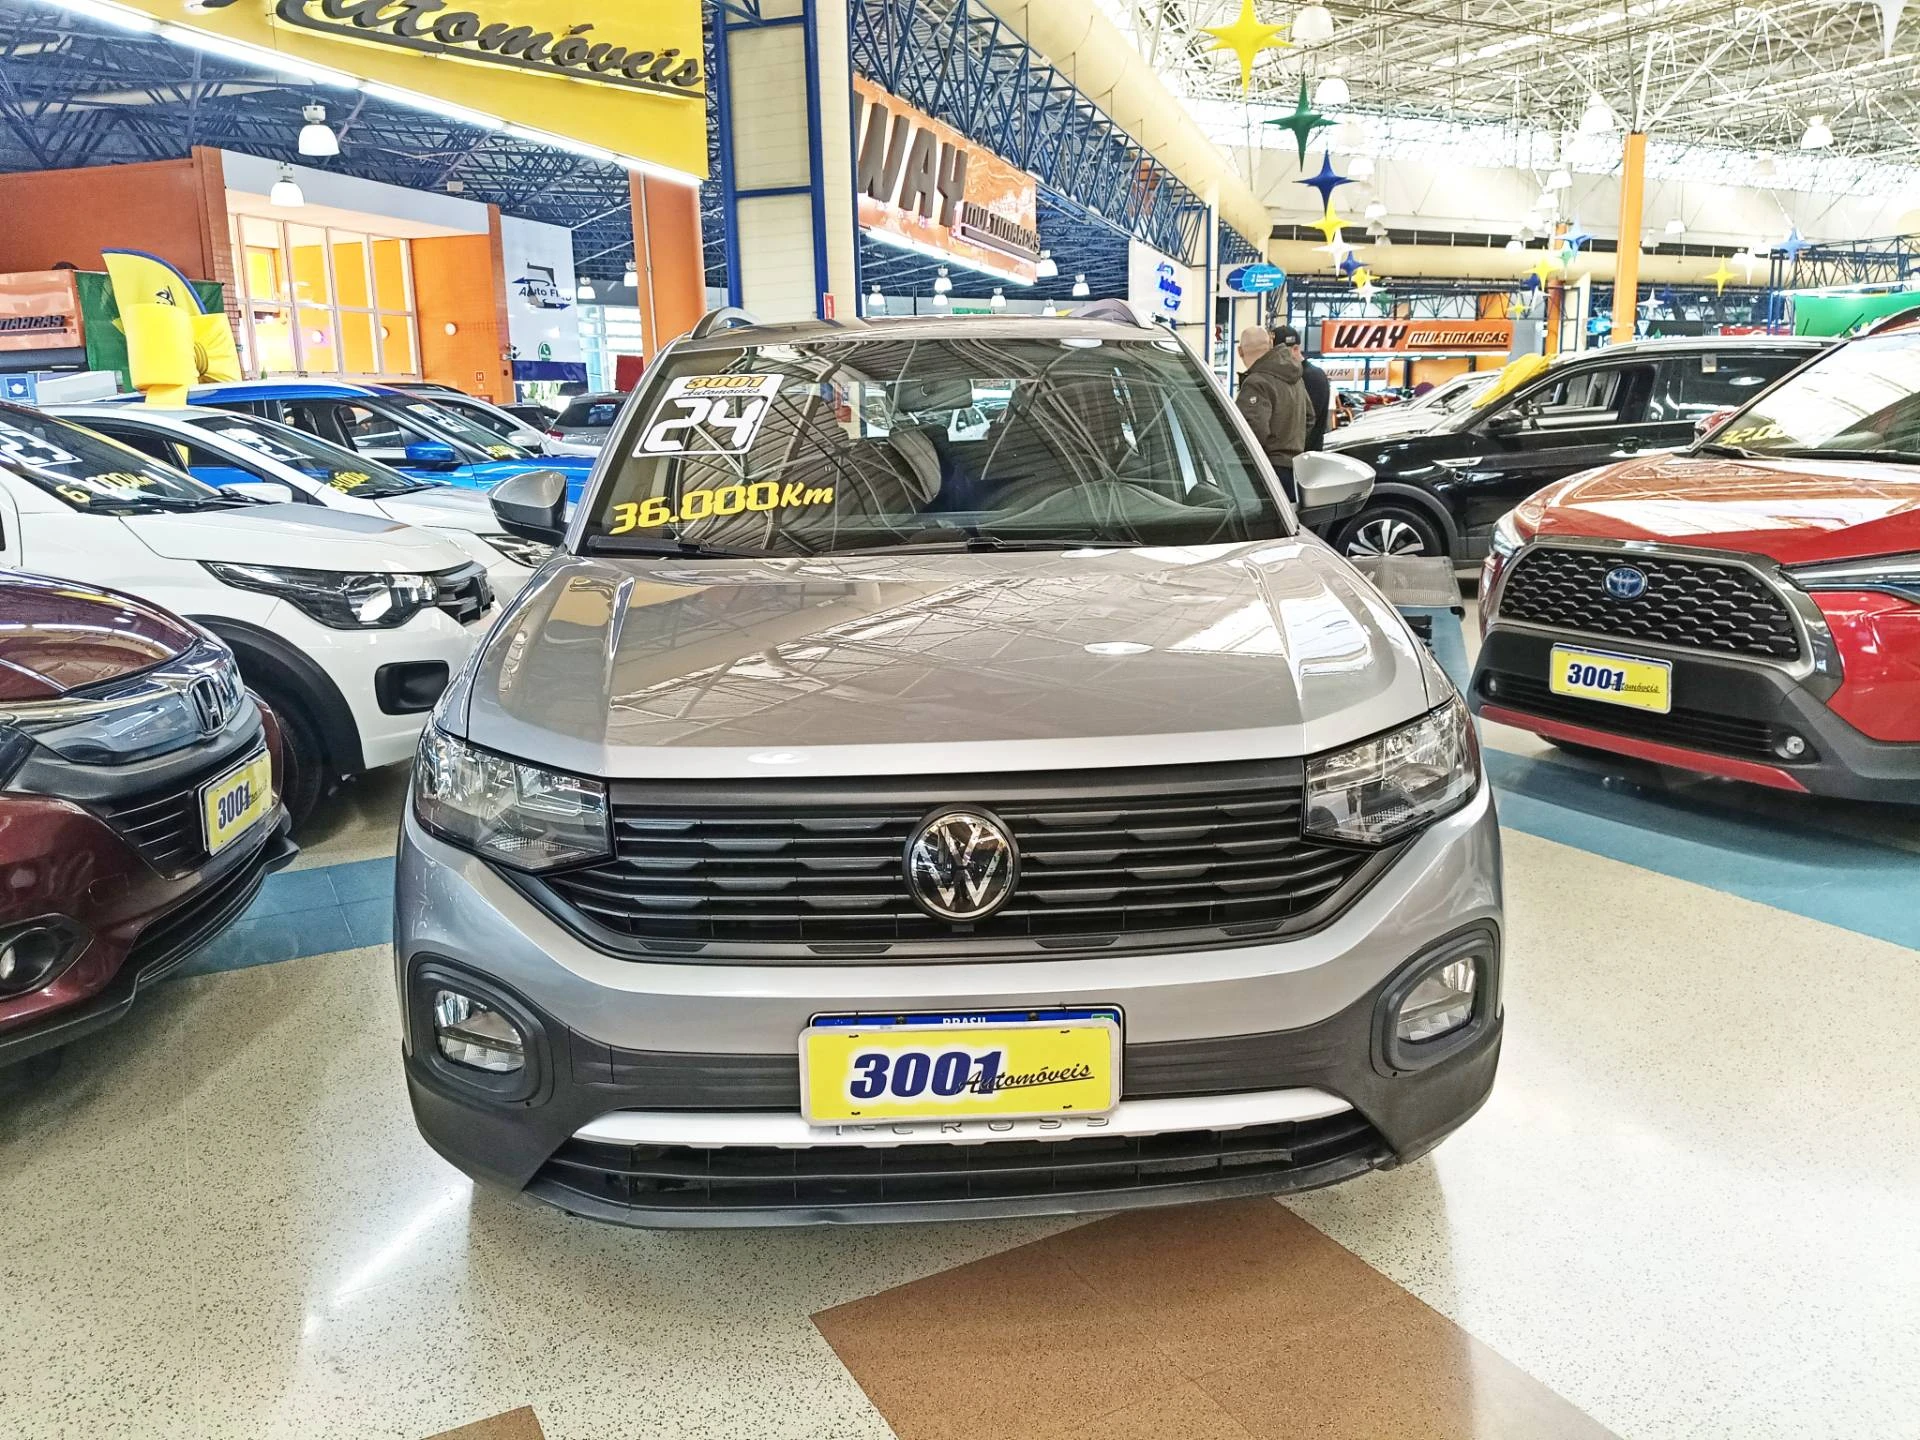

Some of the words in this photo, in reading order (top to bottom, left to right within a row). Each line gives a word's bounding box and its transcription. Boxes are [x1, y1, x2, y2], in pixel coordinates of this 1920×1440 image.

[853, 90, 969, 228] WAY
[960, 201, 1041, 255] MULTIMARCAS
[1334, 325, 1408, 349] WAY
[1409, 331, 1510, 344] MULTIMARCAS
[684, 376, 768, 389] 3001
[643, 398, 766, 452] 24
[1567, 663, 1624, 692] 3001
[218, 781, 251, 830] 3001
[850, 1051, 1002, 1099] 3001
[957, 1062, 1094, 1094] Automóveis
